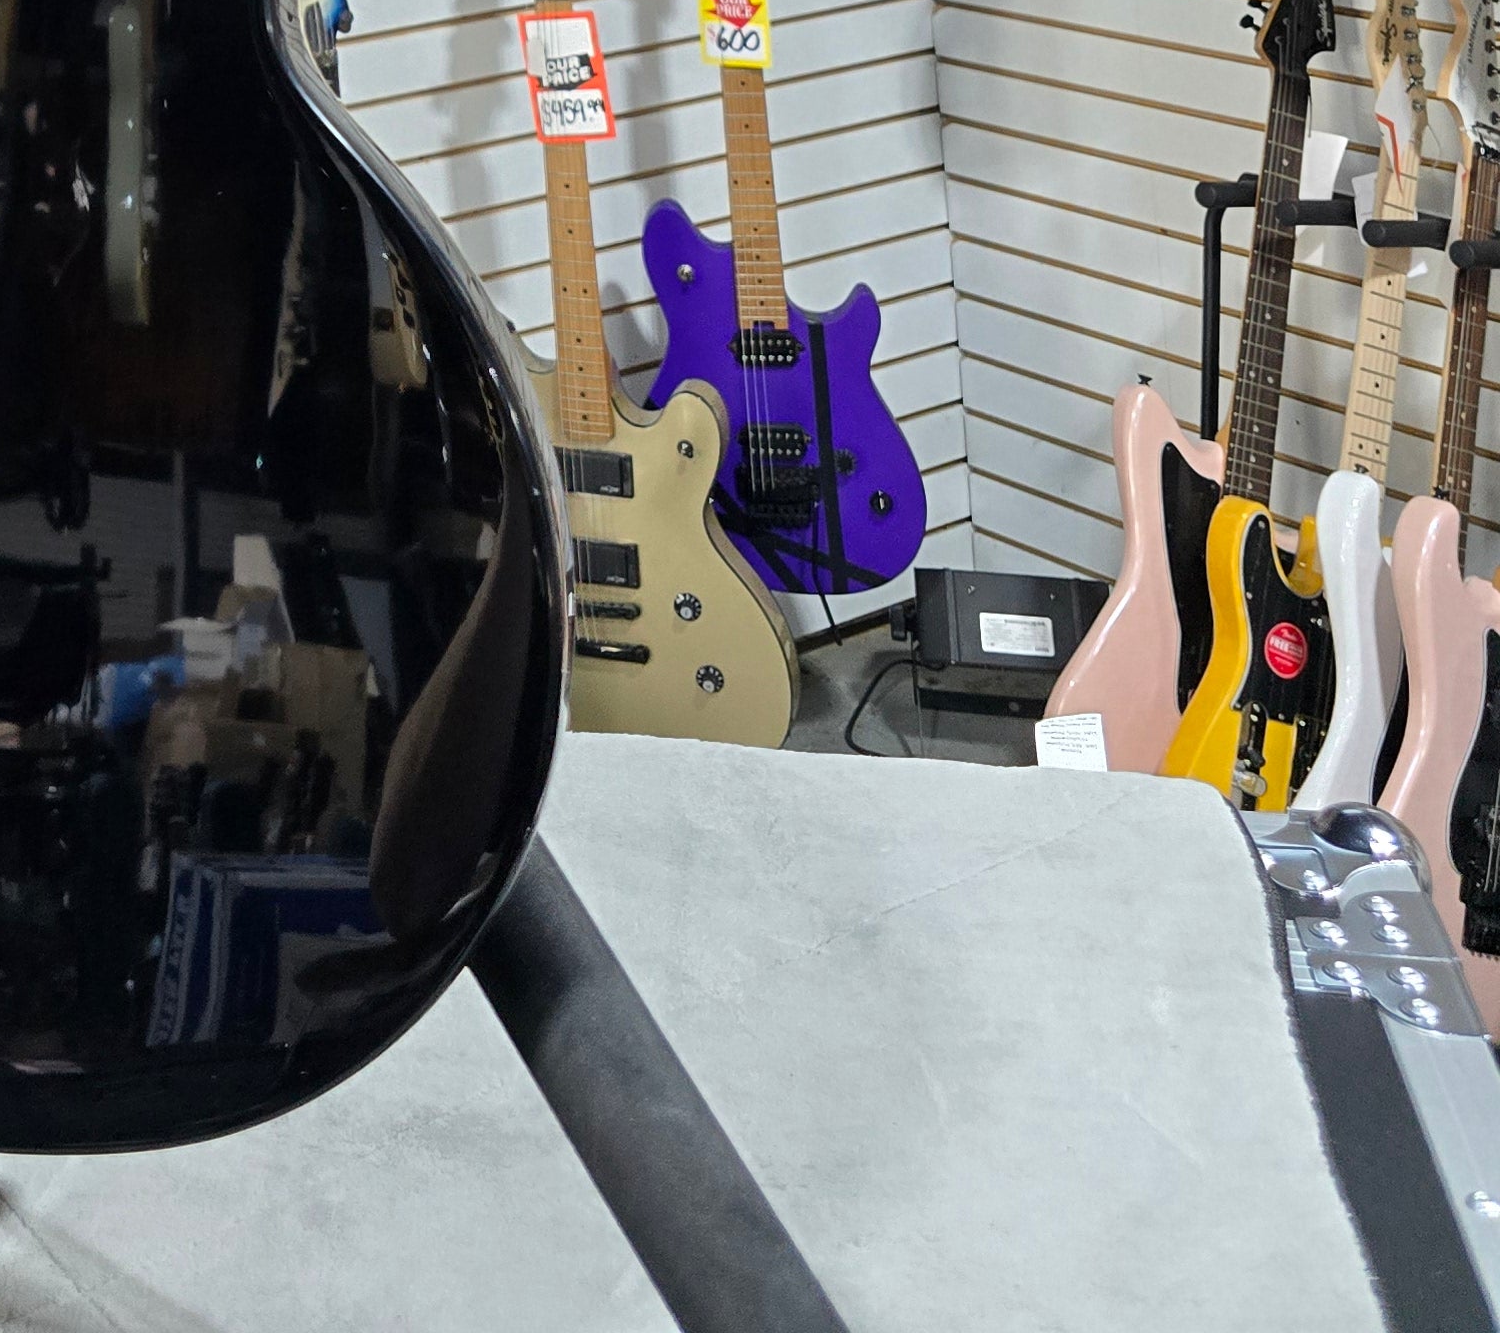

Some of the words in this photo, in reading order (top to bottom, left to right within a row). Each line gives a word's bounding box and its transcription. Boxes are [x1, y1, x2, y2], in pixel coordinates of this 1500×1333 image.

[716, 3, 753, 20] PRICE
[546, 55, 580, 73] OUR
[542, 66, 592, 88] PRICE
